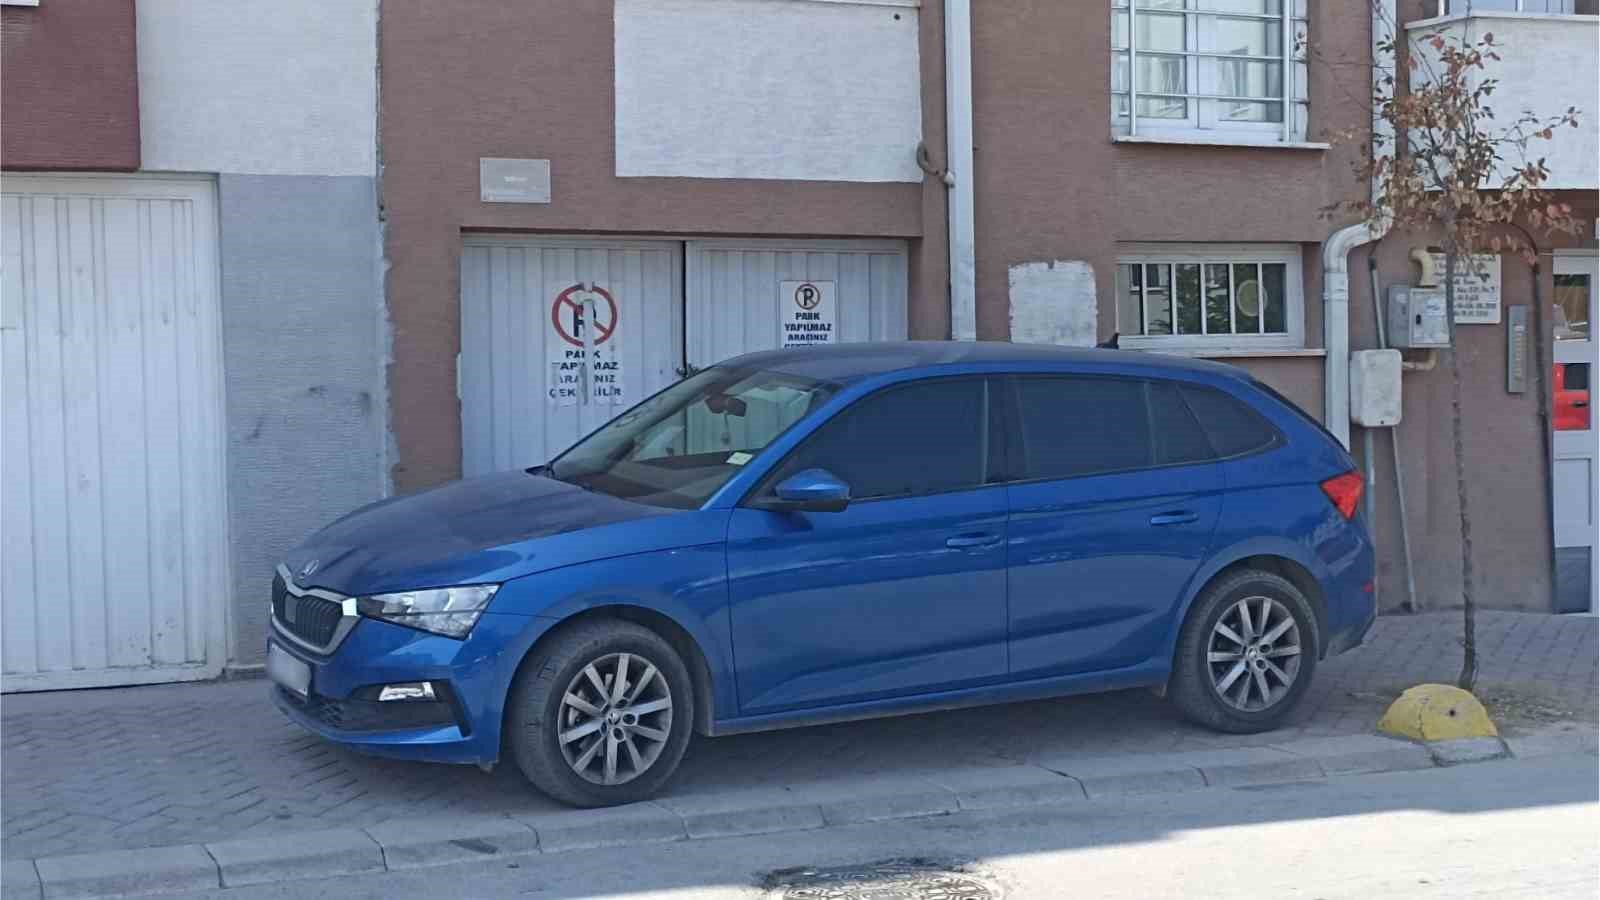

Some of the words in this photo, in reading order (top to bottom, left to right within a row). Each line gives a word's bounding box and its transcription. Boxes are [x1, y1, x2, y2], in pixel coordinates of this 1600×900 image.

[795, 312, 820, 320] PARK
[784, 323, 832, 331] YAPILMAZ
[565, 350, 601, 359] PAK
